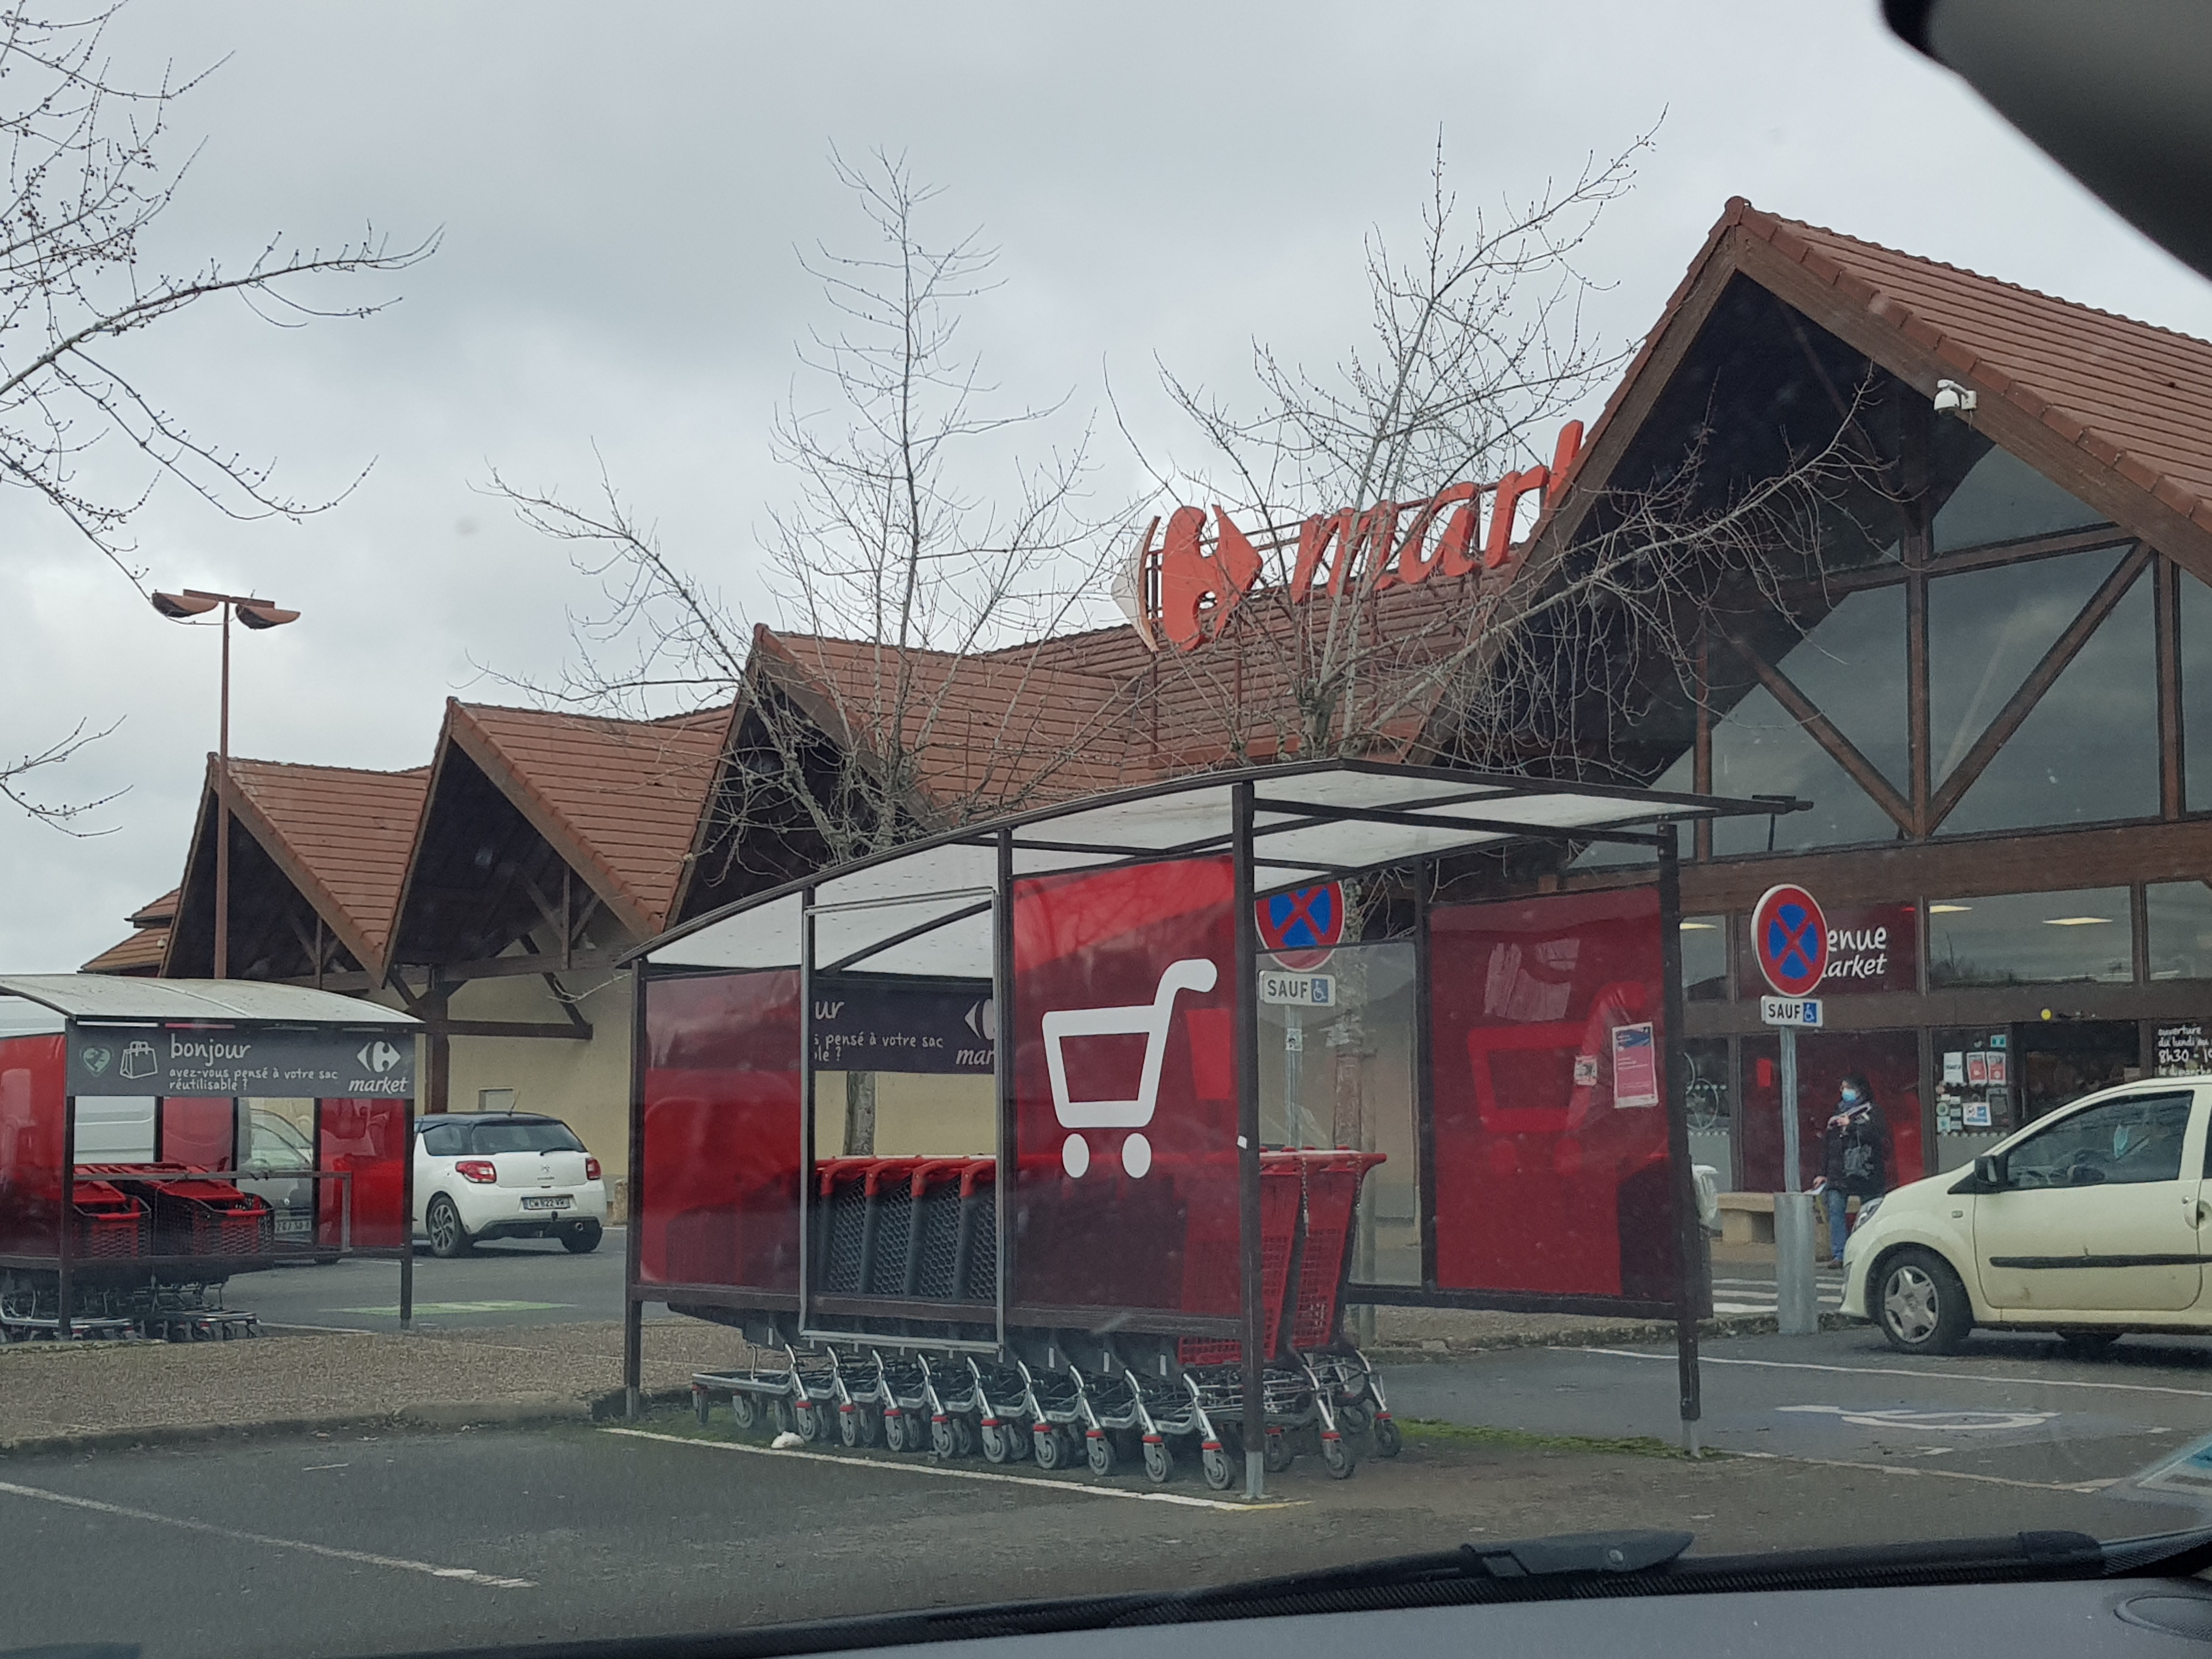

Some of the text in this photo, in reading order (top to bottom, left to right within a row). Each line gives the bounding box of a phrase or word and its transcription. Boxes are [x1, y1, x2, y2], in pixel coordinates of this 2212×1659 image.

[1822, 953, 1888, 978] arket
[1268, 979, 1308, 998] SAUF
[1768, 1003, 1801, 1019] SAUF
[171, 1032, 251, 1066] bonjour
[825, 1032, 864, 1050] pensé
[870, 1032, 877, 1046] à
[882, 1032, 917, 1047] votre
[922, 1040, 943, 1048] sac
[2158, 1048, 2189, 1063] 8h30
[170, 1067, 338, 1081] avez-vous pensé à votre sac
[170, 1078, 248, 1091] réutilisable ?
[348, 1076, 409, 1094] market
